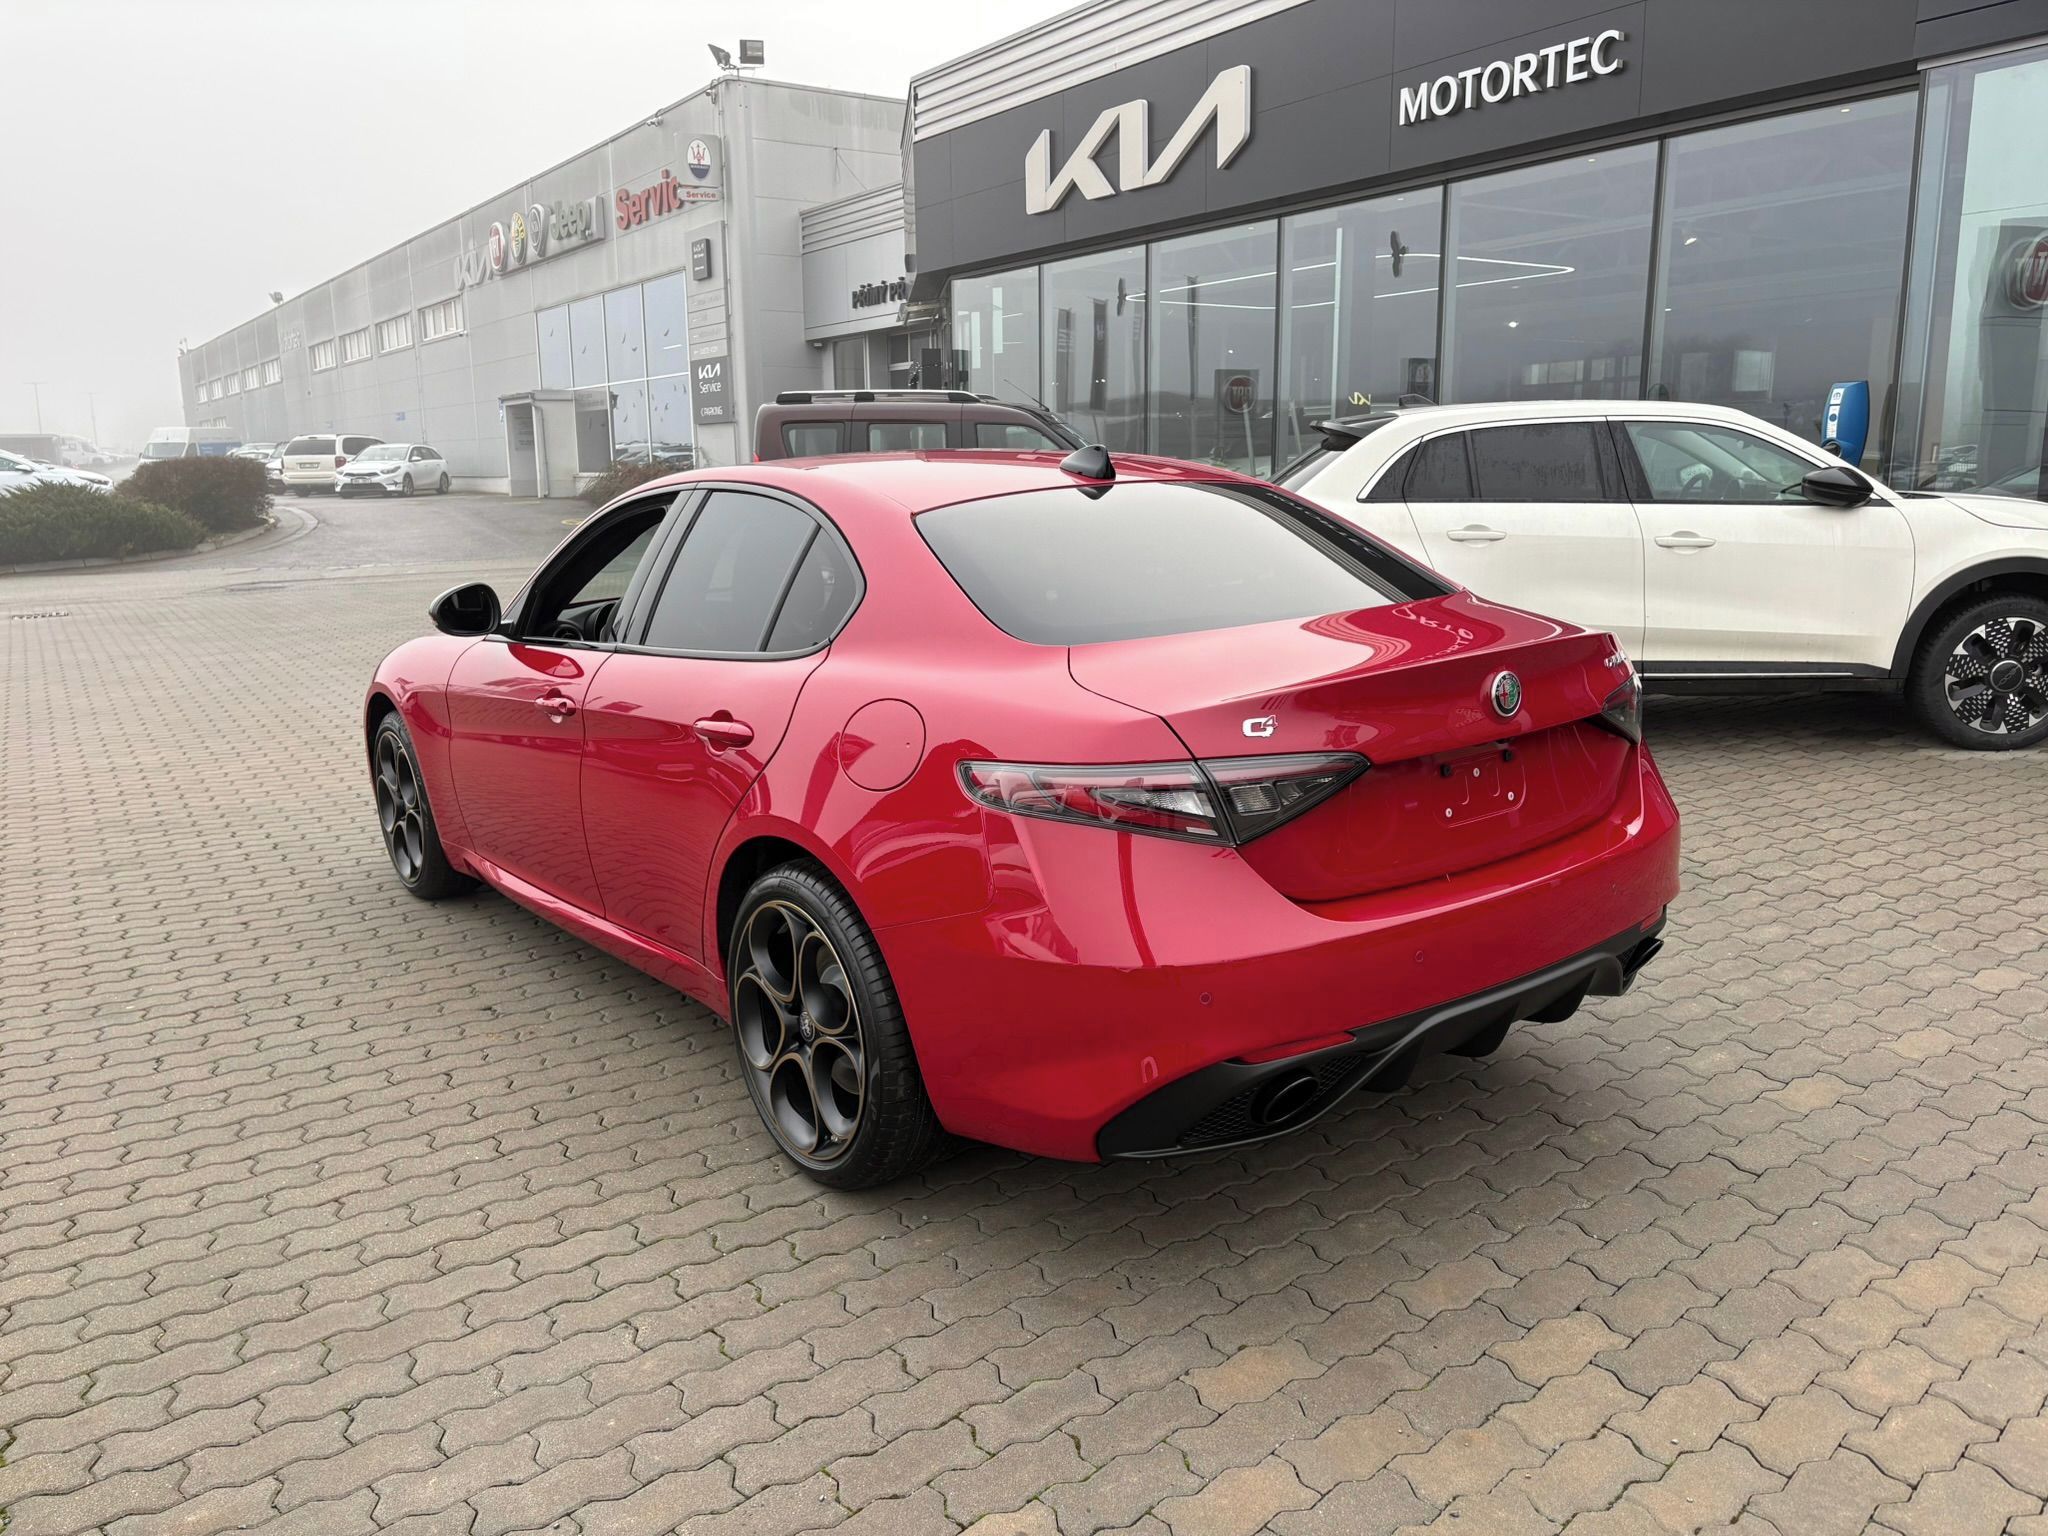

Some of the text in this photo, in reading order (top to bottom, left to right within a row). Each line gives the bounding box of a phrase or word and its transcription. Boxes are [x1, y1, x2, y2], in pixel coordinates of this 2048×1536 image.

[1399, 29, 1625, 126] MOTORTEC
[1025, 65, 1251, 215] KIA
[616, 169, 684, 230] Servic
[686, 190, 717, 199] Service
[550, 200, 590, 240] Jeep
[698, 363, 720, 379] KIA
[699, 380, 721, 394] Service
